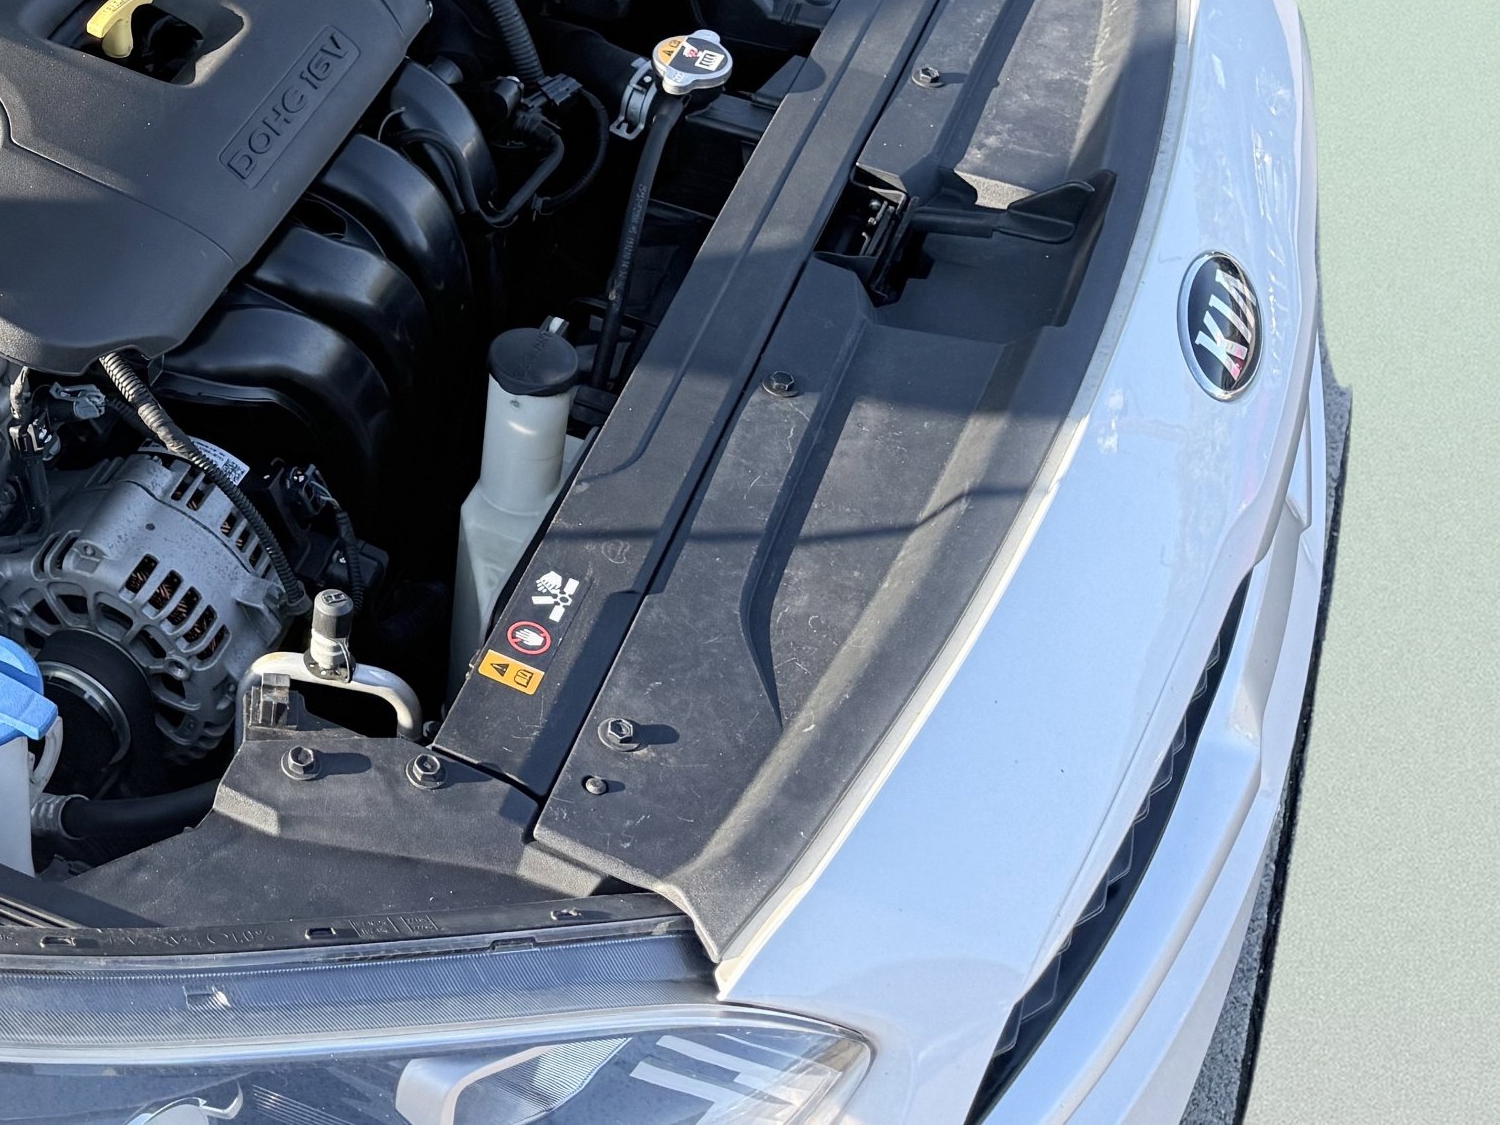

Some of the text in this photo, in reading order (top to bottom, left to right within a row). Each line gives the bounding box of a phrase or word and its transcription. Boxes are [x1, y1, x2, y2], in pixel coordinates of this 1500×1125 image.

[227, 31, 349, 181] DOHC 16V
[1194, 268, 1257, 381] KIA
